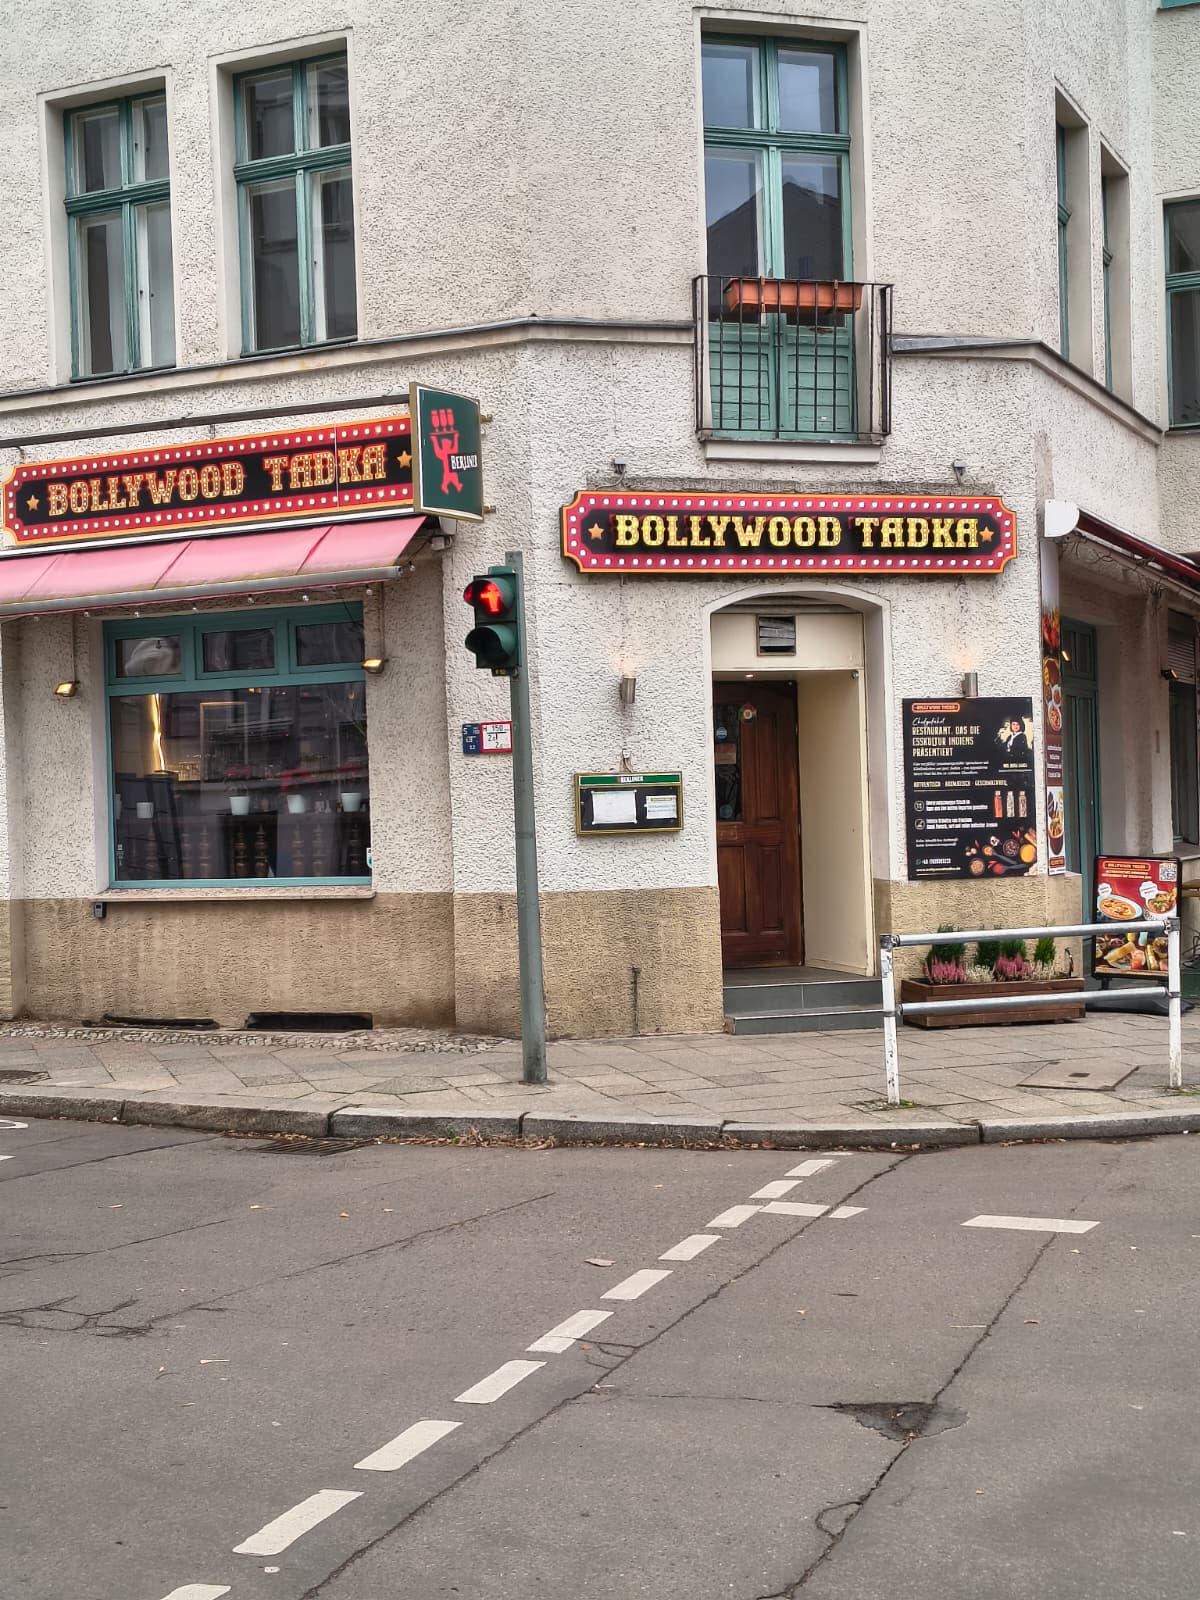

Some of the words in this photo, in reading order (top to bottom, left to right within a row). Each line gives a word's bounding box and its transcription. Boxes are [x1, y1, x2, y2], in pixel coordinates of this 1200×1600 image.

[47, 462, 246, 517] BOLLYWOOD
[262, 443, 387, 492] TADKA
[612, 514, 842, 548] BOLLYWOOD
[853, 515, 980, 549] TADKA
[955, 726, 968, 735] DAS
[969, 725, 981, 735] DIE
